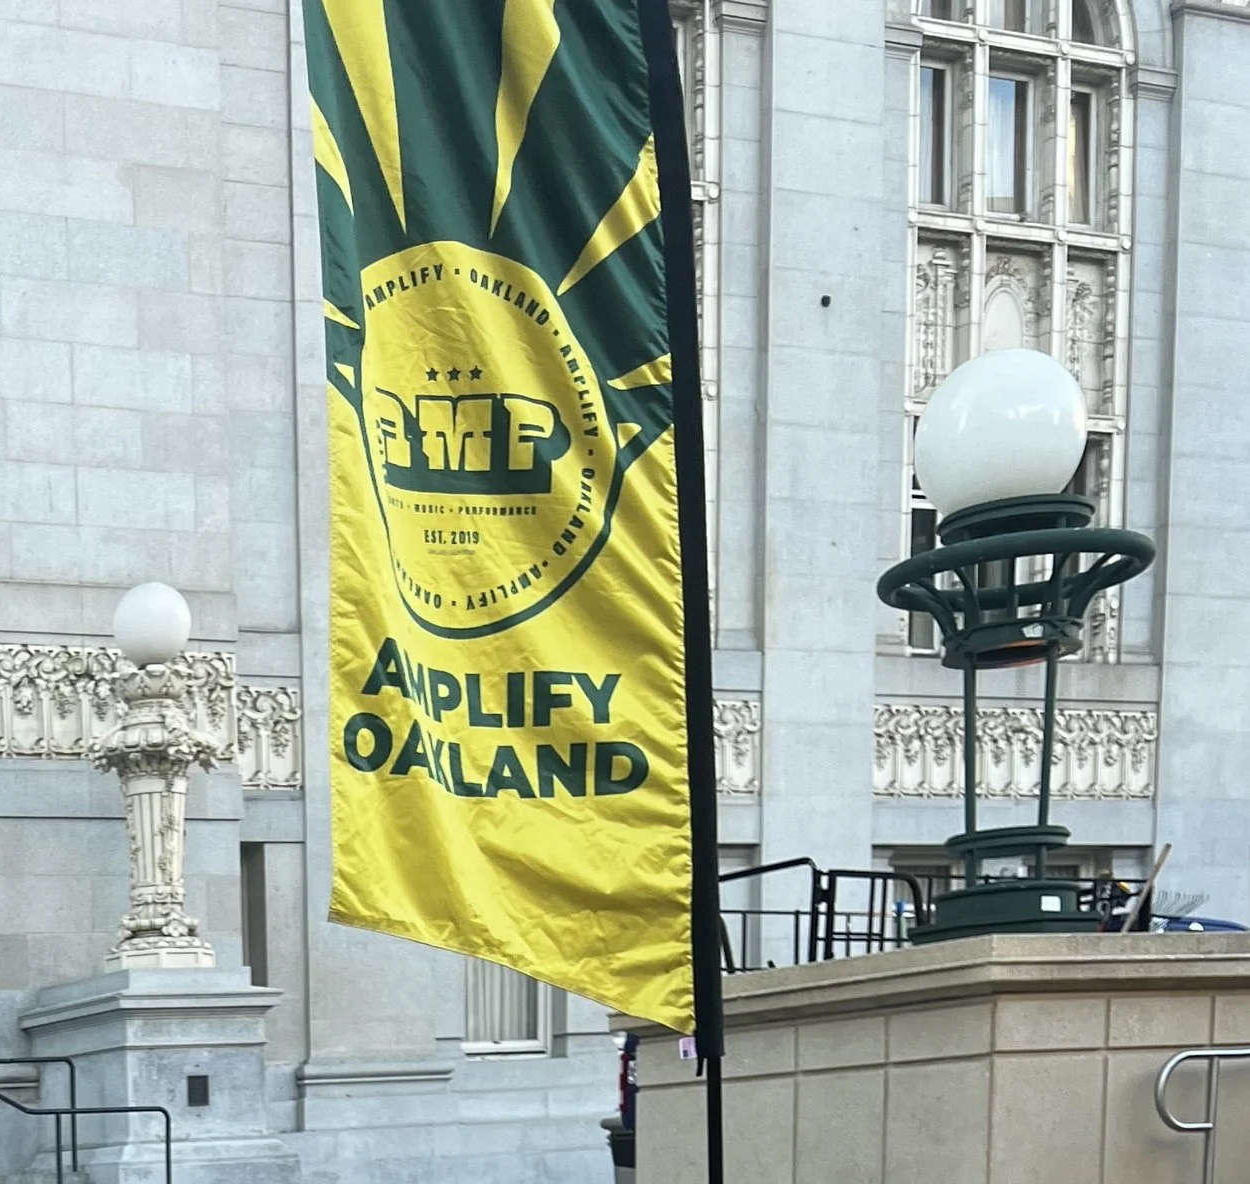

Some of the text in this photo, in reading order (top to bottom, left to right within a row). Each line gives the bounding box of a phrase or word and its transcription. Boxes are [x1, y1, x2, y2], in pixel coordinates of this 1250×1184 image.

[365, 264, 599, 610] AMPLIFY OAKLAND AMPLIFY OAKLAND AMPLIFY OAKLA
[414, 503, 445, 514] MUSIC
[458, 505, 538, 516] PERFORMANCE
[424, 529, 480, 545] EST. 2019
[361, 637, 622, 729] AMPLIFY
[343, 712, 650, 799] OAKLAND
